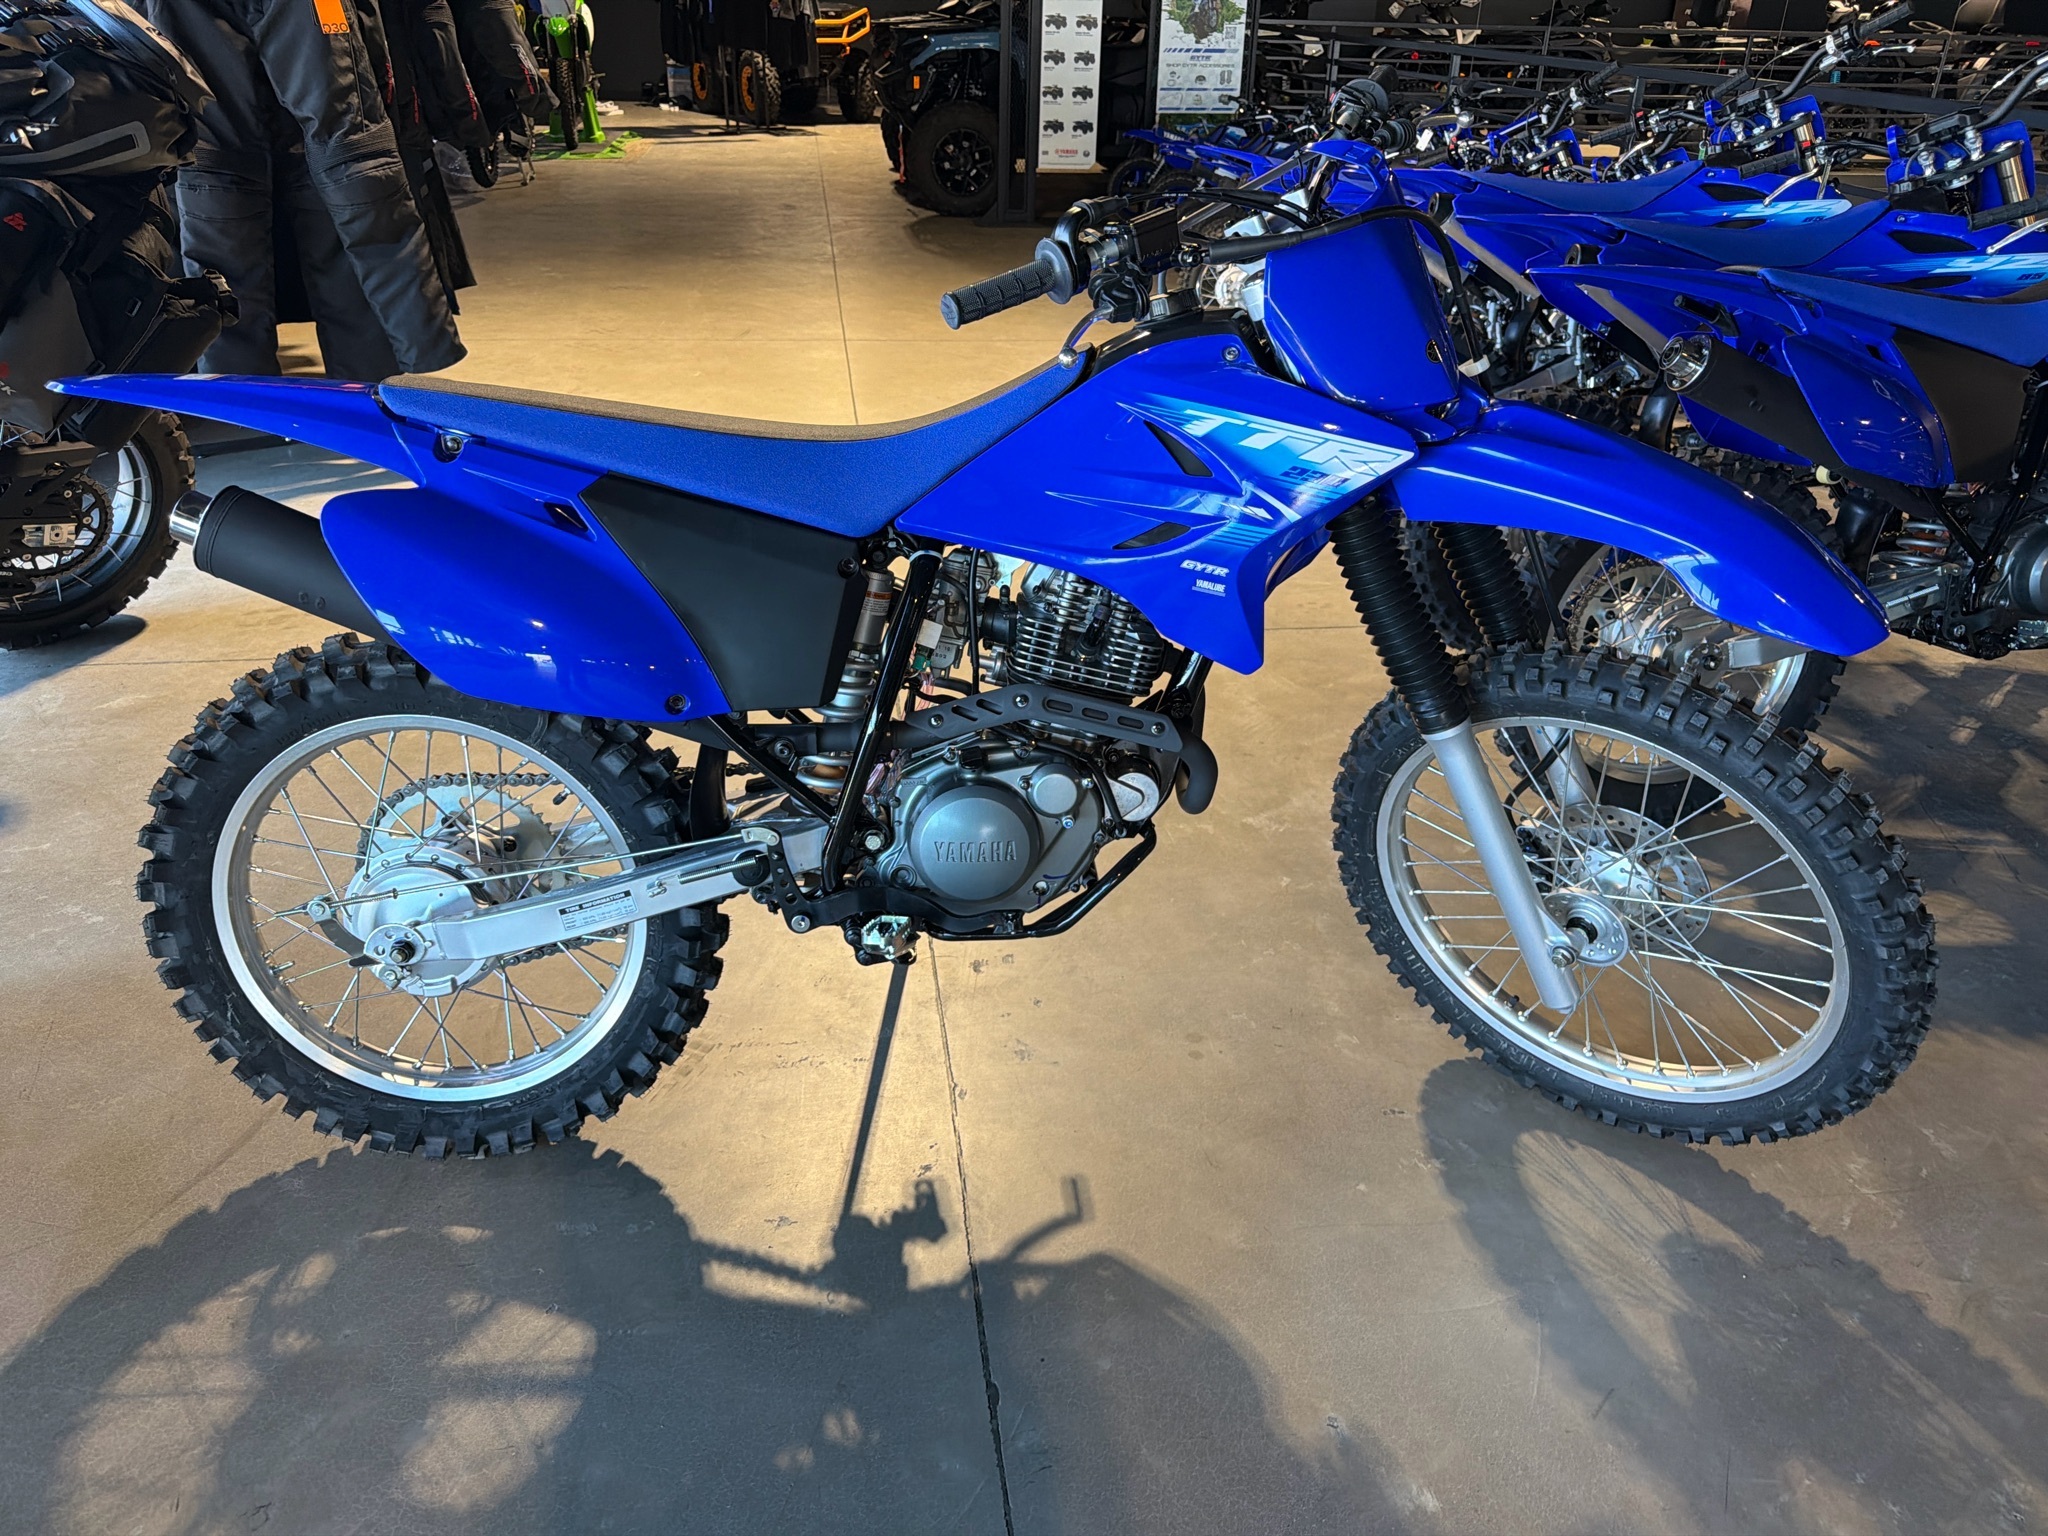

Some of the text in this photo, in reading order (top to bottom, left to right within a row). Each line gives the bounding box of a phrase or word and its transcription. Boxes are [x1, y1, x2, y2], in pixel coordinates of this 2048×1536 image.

[1279, 465, 1352, 489] 230
[1180, 559, 1230, 577] GYTR
[1195, 578, 1226, 593] YAMALUBE
[934, 839, 1018, 864] YAMAHA
[582, 892, 626, 909] INFORMATION
